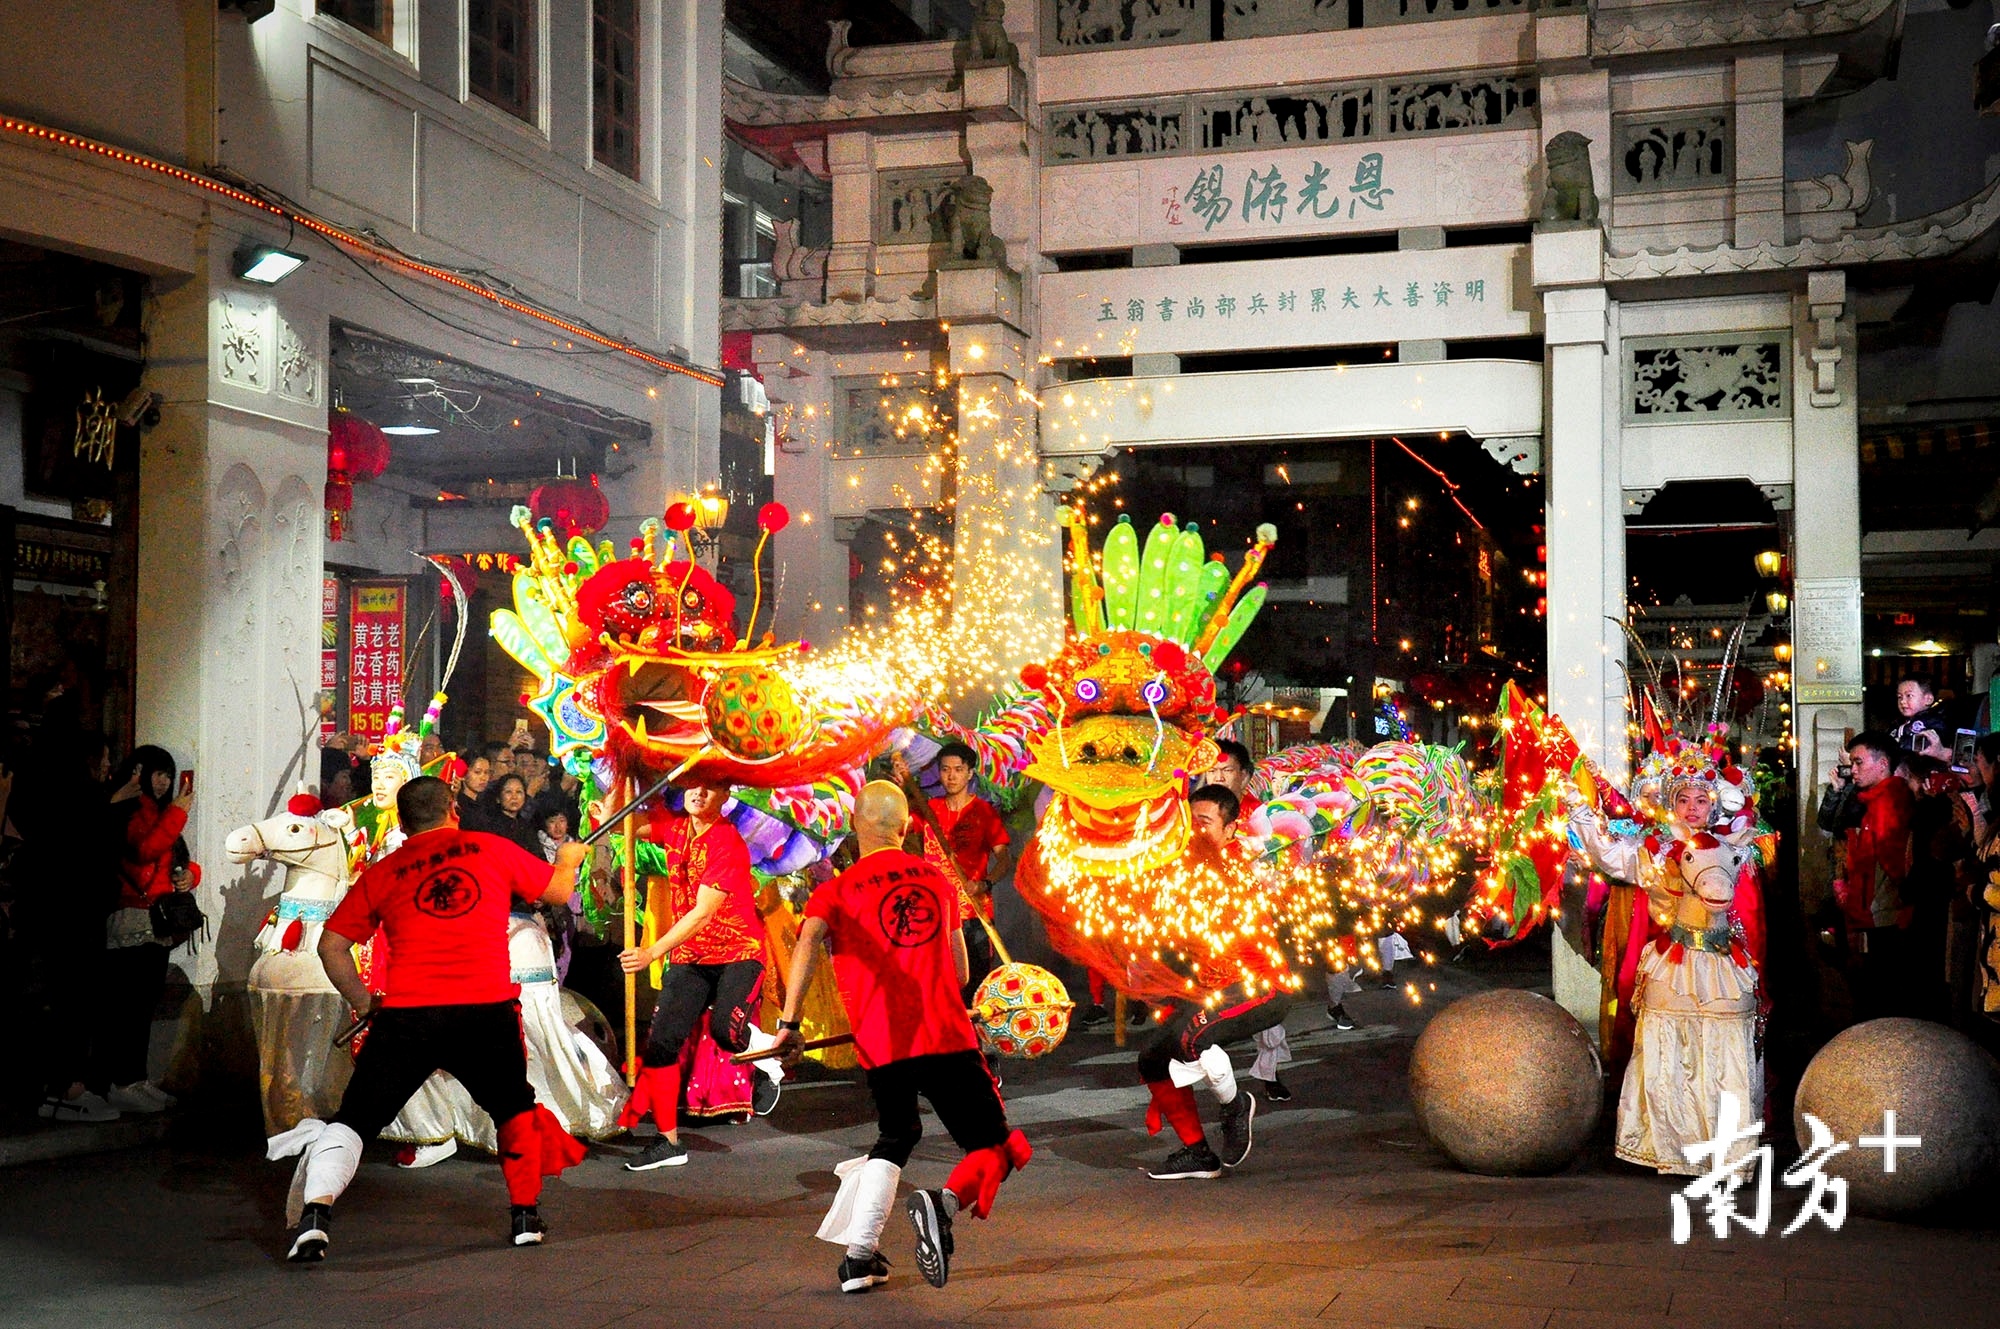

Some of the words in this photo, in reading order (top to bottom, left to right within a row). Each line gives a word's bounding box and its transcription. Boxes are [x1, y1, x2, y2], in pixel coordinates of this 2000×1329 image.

[369, 622, 384, 706] 老香黄
[352, 712, 367, 731] 15
[369, 712, 384, 731] 15
